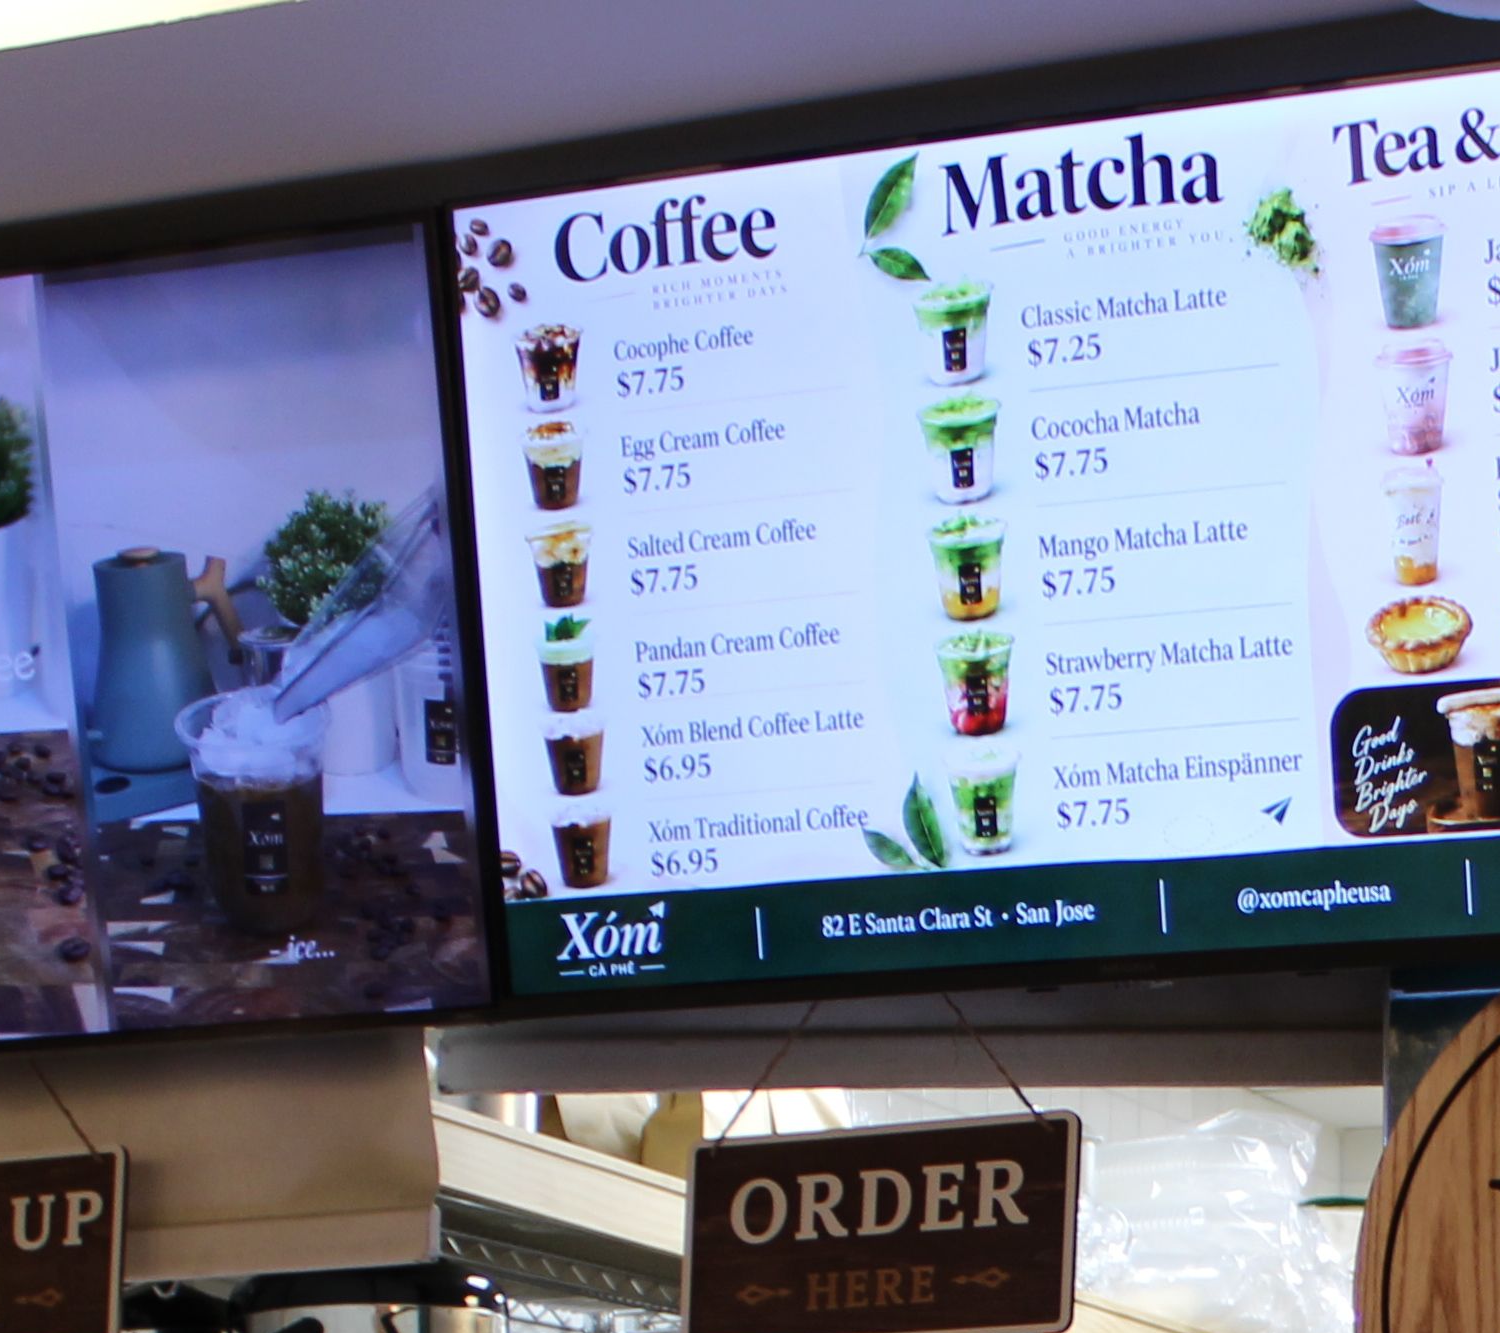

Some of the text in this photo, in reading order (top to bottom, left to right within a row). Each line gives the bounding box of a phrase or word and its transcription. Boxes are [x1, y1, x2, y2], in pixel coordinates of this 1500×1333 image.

[1332, 118, 1445, 188] Tea
[1454, 107, 1500, 164] &
[940, 132, 1224, 237] Matcha
[554, 195, 778, 282] Coffee
[1063, 218, 1183, 243] GOOD ENERGY
[1020, 285, 1227, 329] Classic Matcha Latte
[613, 325, 754, 362] Cocophe Coffee
[1028, 333, 1102, 366] $7.25
[615, 364, 685, 399] $7.75
[620, 418, 786, 461] Egg Cream Coffee
[1031, 402, 1200, 441] Cococha Matcha
[623, 463, 691, 496] $7.75
[1035, 447, 1108, 481] $7.75
[627, 519, 817, 560] Salted Cream Coffee
[1038, 519, 1248, 561] Mango Matcha Latte
[630, 565, 698, 597] $7.75
[1041, 565, 1116, 600] $7.75
[635, 624, 841, 663] Pandan Cream Coffee
[1045, 633, 1293, 678] Strawberry Matcha Latte
[638, 669, 705, 698] $7.75
[1049, 683, 1122, 717] $7.75
[642, 708, 864, 749] Xóm Blend Coffee Latte
[1351, 717, 1401, 758] Good
[643, 754, 711, 784] $6.95
[1053, 751, 1302, 788] Xóm Matcha Einspänner
[1354, 749, 1415, 783] Drinks
[1355, 767, 1427, 813] Brighter
[648, 806, 868, 844] Xóm Traditional Coffee
[1057, 798, 1130, 830] $7.75
[1368, 800, 1417, 834] Days
[651, 849, 718, 878] $6.95
[1237, 881, 1391, 915] @xomcapheusa
[556, 909, 663, 961] Xóm
[822, 900, 1094, 938] 82 E Santa Clara St San Jose
[730, 1158, 1030, 1246] ORDER
[806, 1265, 936, 1312] HERE
